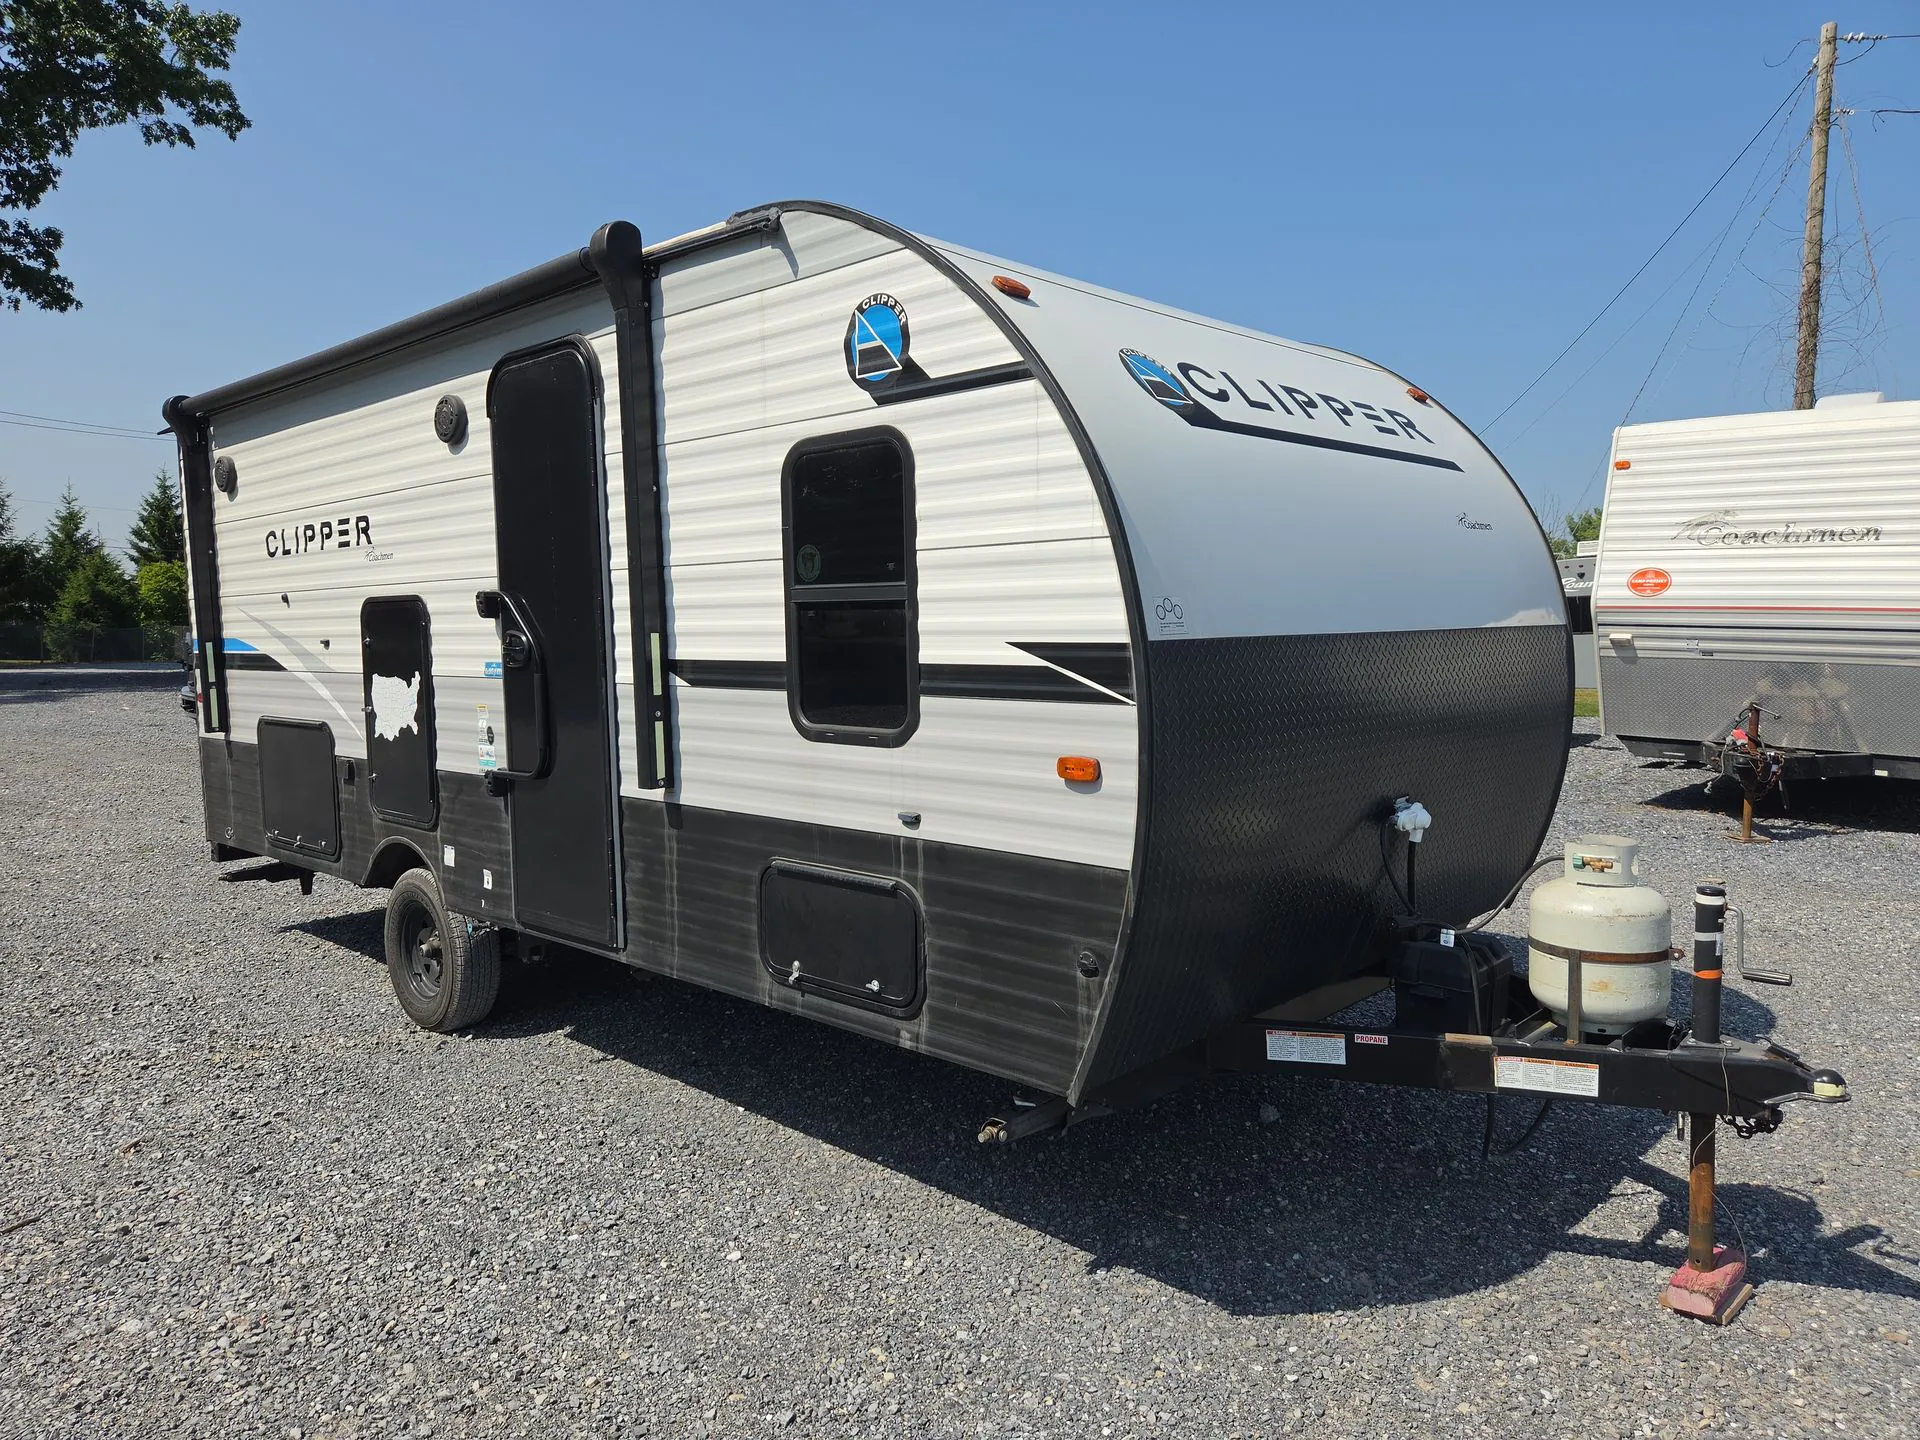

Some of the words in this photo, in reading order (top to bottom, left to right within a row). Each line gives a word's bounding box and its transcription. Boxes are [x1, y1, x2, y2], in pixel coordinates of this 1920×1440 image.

[862, 294, 907, 326] CLIPPER
[1177, 362, 1436, 445] CLIPPER
[265, 515, 373, 558] CLIPPER
[1463, 520, 1494, 531] Coachmen
[1696, 521, 1883, 546] Coachmen
[368, 551, 394, 562] Coachmen
[1356, 1035, 1387, 1044] PROPANE
